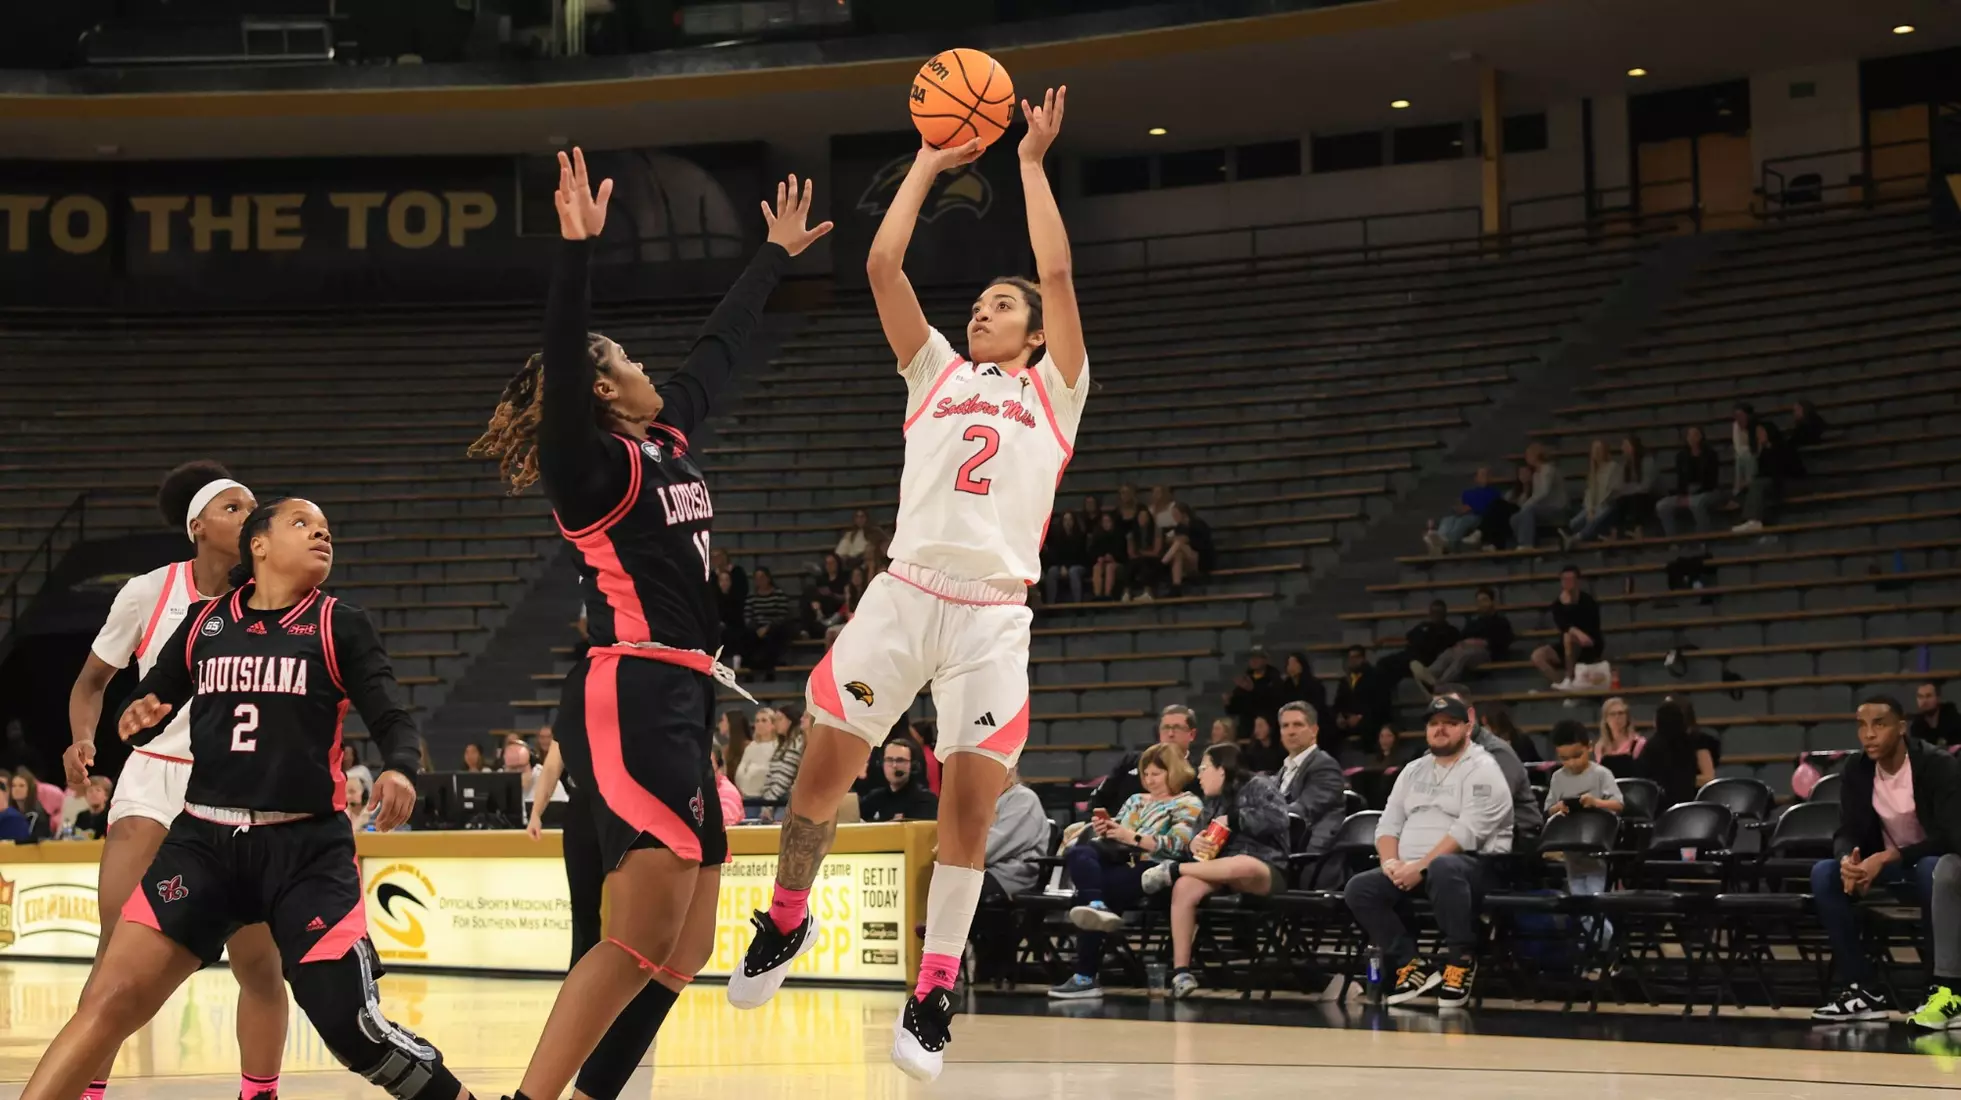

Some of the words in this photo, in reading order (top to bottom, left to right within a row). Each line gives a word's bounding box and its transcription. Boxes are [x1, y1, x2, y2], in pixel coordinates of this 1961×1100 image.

[927, 58, 950, 80] son
[0, 193, 109, 254] TO
[129, 193, 307, 252] THE
[329, 191, 497, 249] TOP
[933, 393, 999, 419] Southern
[1002, 399, 1036, 429] Miss
[954, 424, 1000, 496] 2
[198, 656, 307, 696] LOUISIANA
[230, 703, 259, 752] 2
[823, 863, 851, 879] game
[863, 868, 884, 886] GET
[887, 868, 897, 885] IT
[439, 897, 475, 910] OFFICIAL
[477, 897, 509, 911] SPORTS
[512, 898, 552, 911] MEDICINE
[719, 886, 774, 920] HER
[811, 886, 851, 921] ISS
[863, 890, 898, 909] TODAY
[453, 915, 469, 928] FOR
[472, 916, 517, 929] SOUTHERN
[519, 917, 540, 930] MISS
[716, 925, 750, 971] ED
